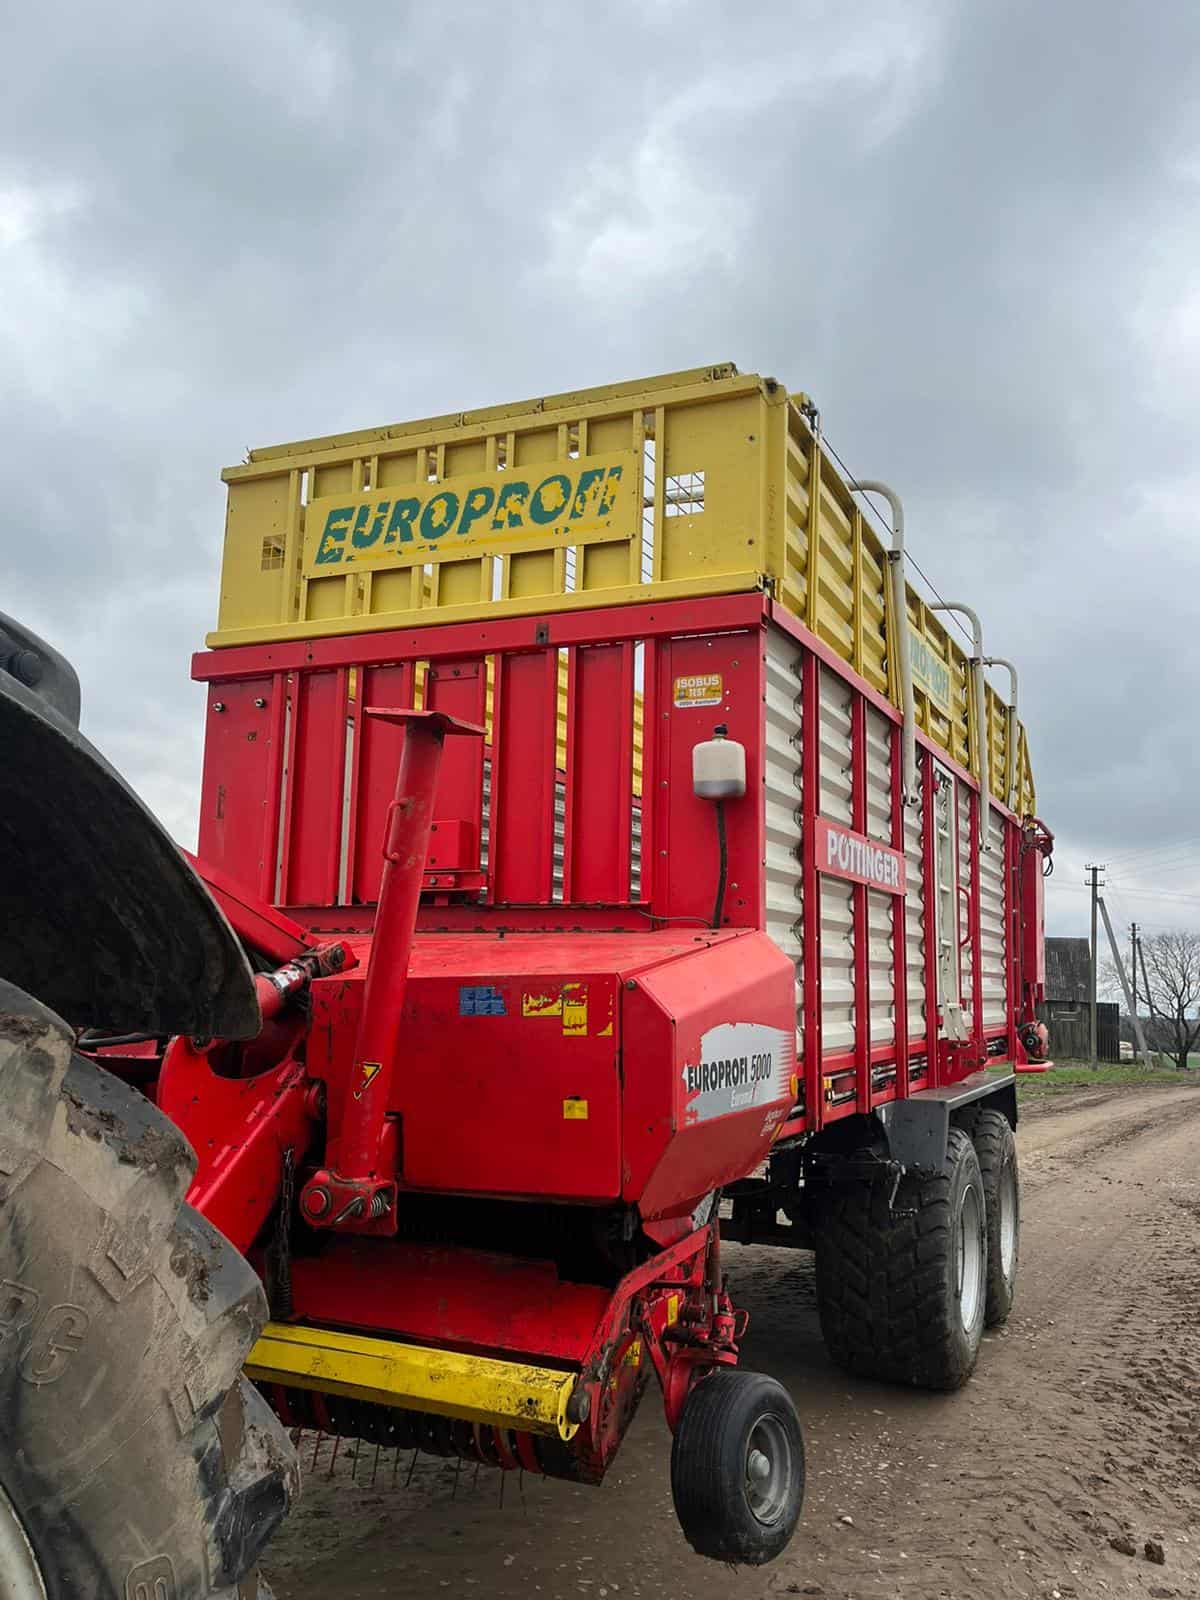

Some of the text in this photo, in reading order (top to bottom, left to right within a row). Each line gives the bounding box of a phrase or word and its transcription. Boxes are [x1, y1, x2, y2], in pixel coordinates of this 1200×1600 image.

[315, 465, 622, 564] EUROPROFI
[676, 673, 720, 689] ISOBUS
[827, 829, 899, 888] PÖTTINGER
[687, 1053, 772, 1094] EUROPROFI 5000
